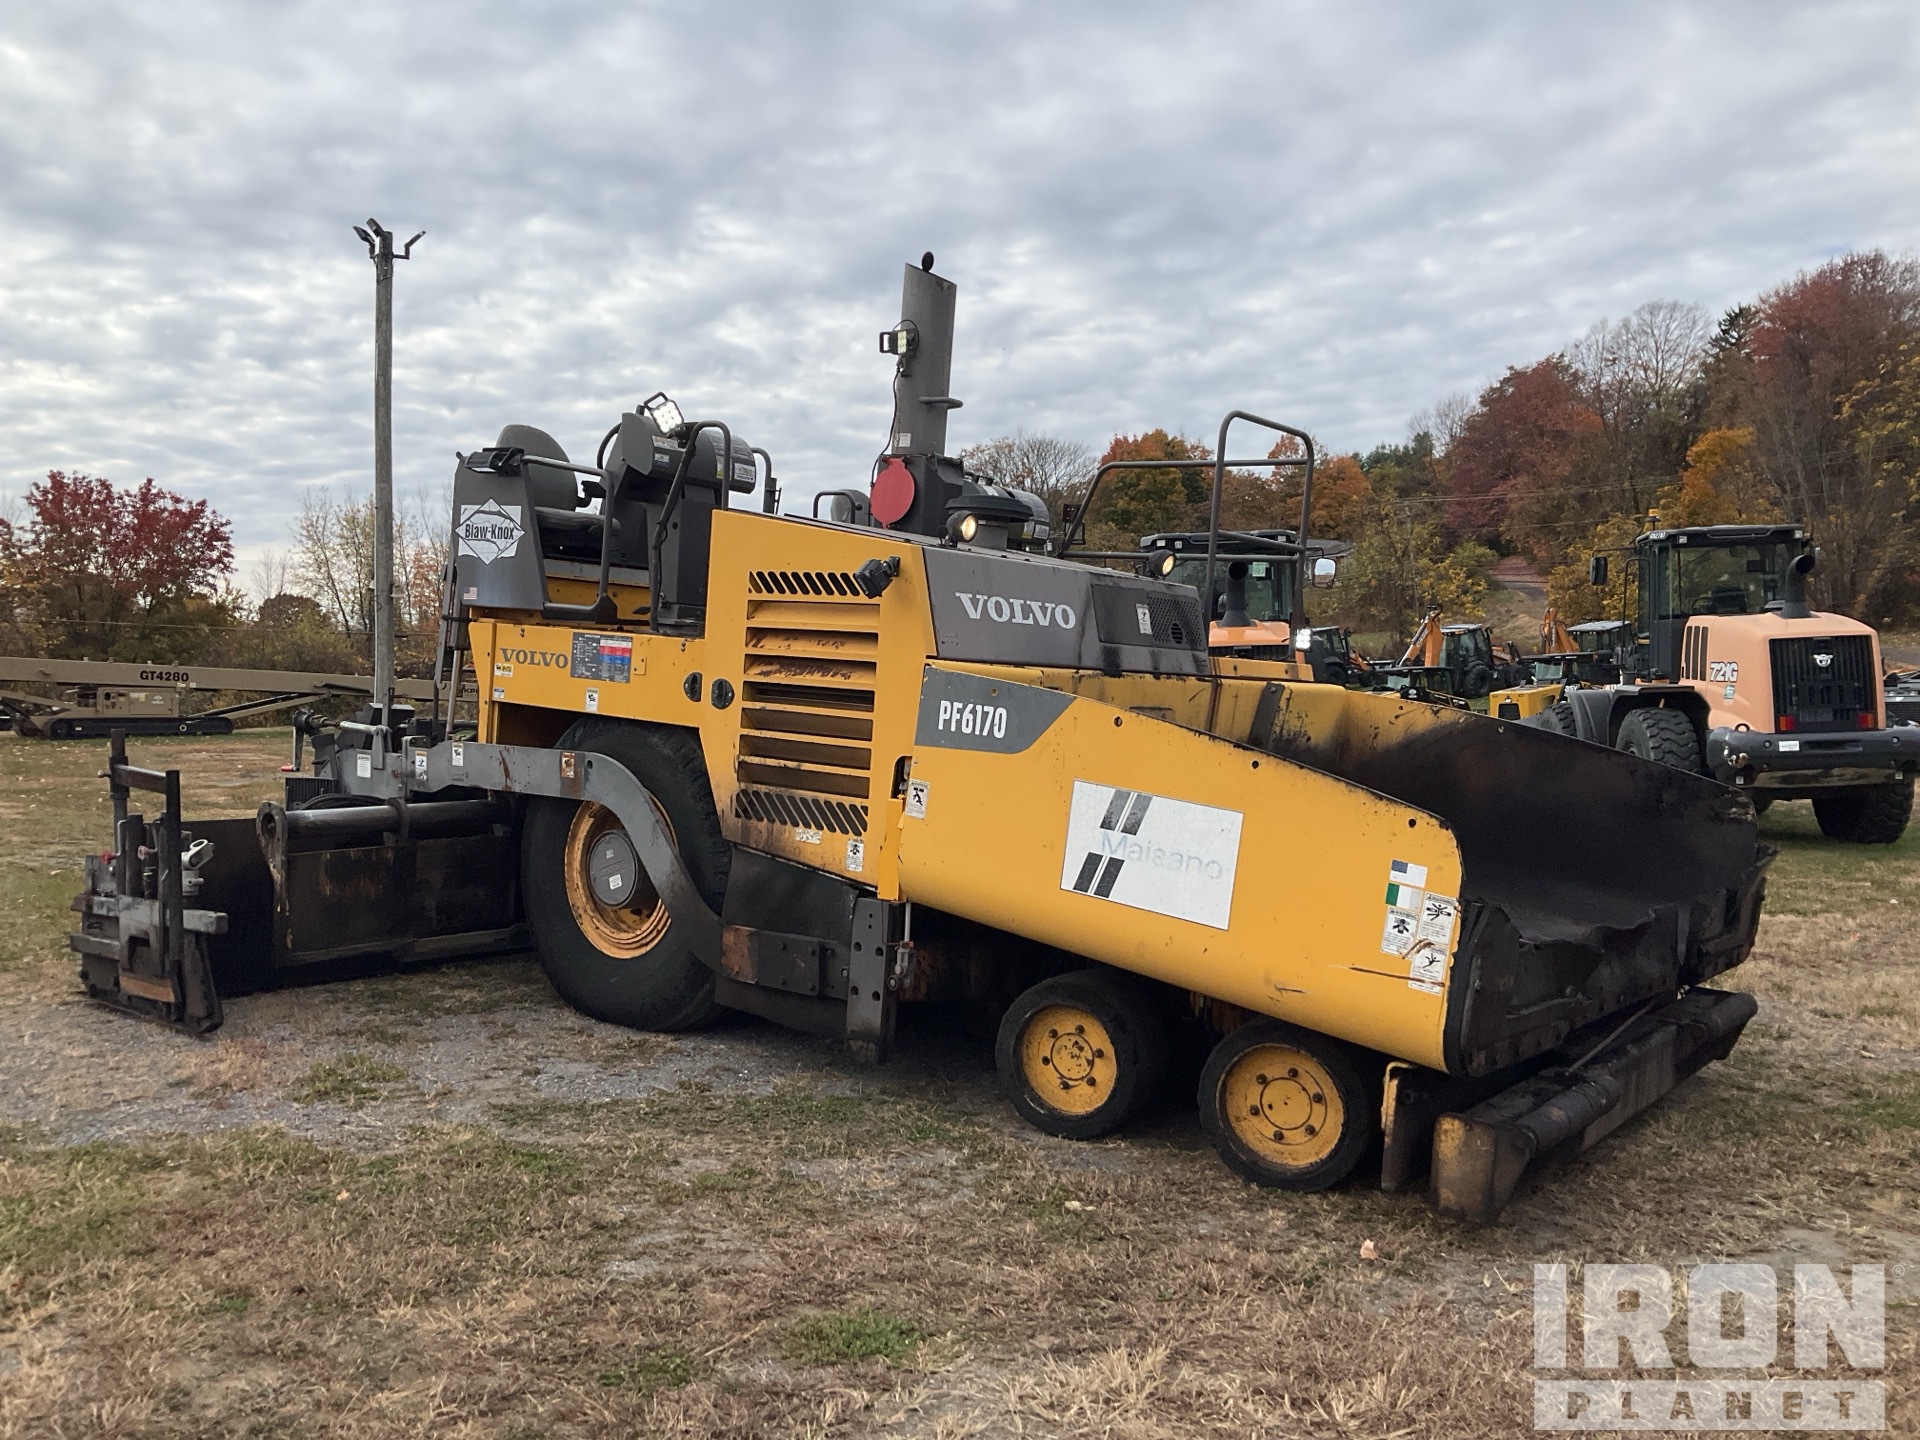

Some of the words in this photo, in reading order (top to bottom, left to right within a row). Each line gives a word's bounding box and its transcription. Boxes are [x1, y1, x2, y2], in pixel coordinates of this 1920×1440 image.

[464, 523, 514, 540] Blaw-Knox
[955, 592, 1076, 630] VOLVO
[500, 648, 569, 669] VOLVO
[140, 670, 189, 682] GT4280
[1709, 661, 1738, 683] 721G
[938, 700, 1008, 739] PF6170
[1099, 830, 1223, 880] Maisano
